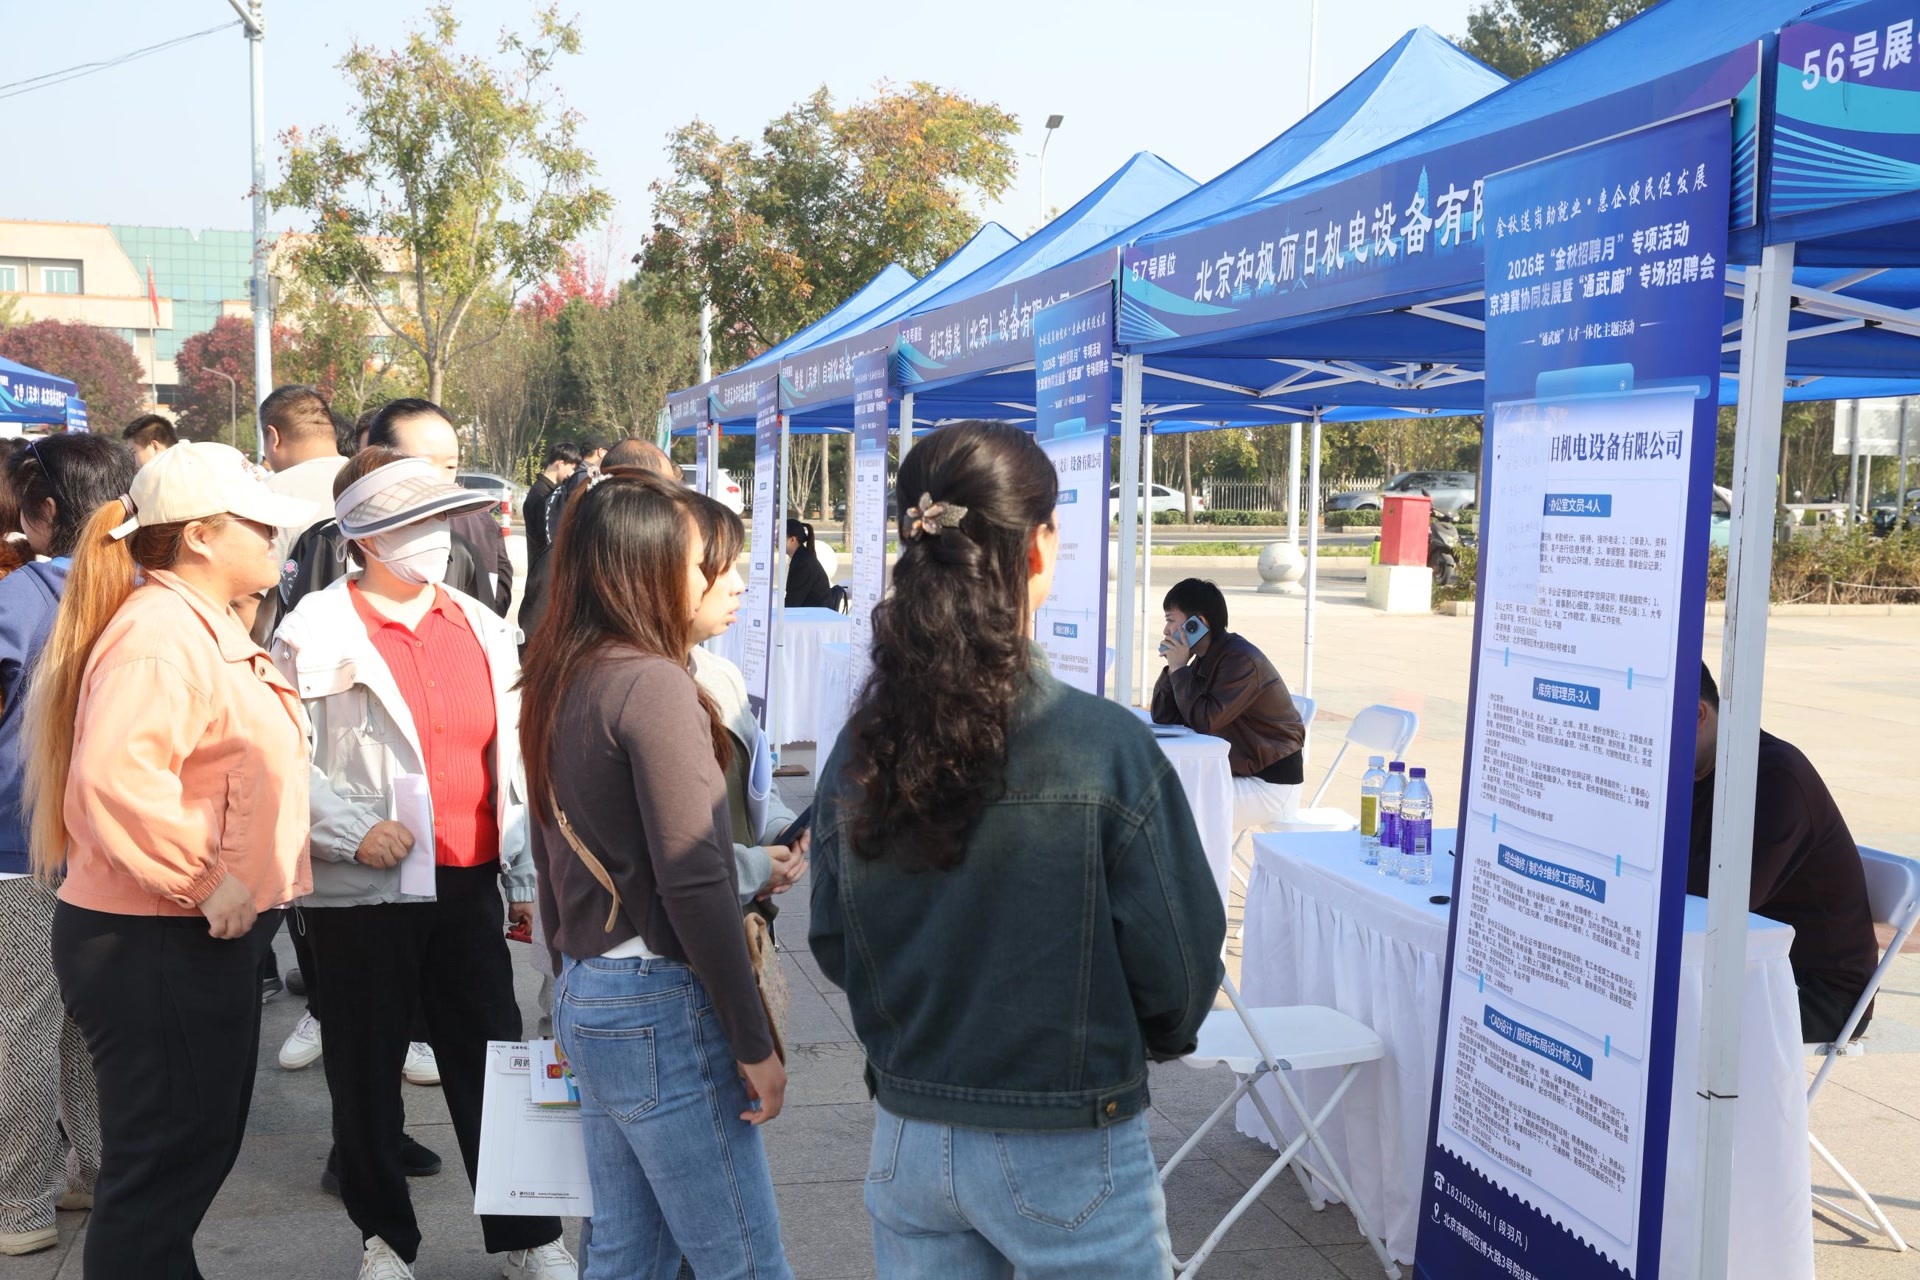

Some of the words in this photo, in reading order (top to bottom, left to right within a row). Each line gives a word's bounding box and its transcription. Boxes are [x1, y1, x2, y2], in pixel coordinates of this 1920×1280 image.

[1802, 18, 1920, 91] 56号展
[1132, 254, 1177, 283] 57号展位
